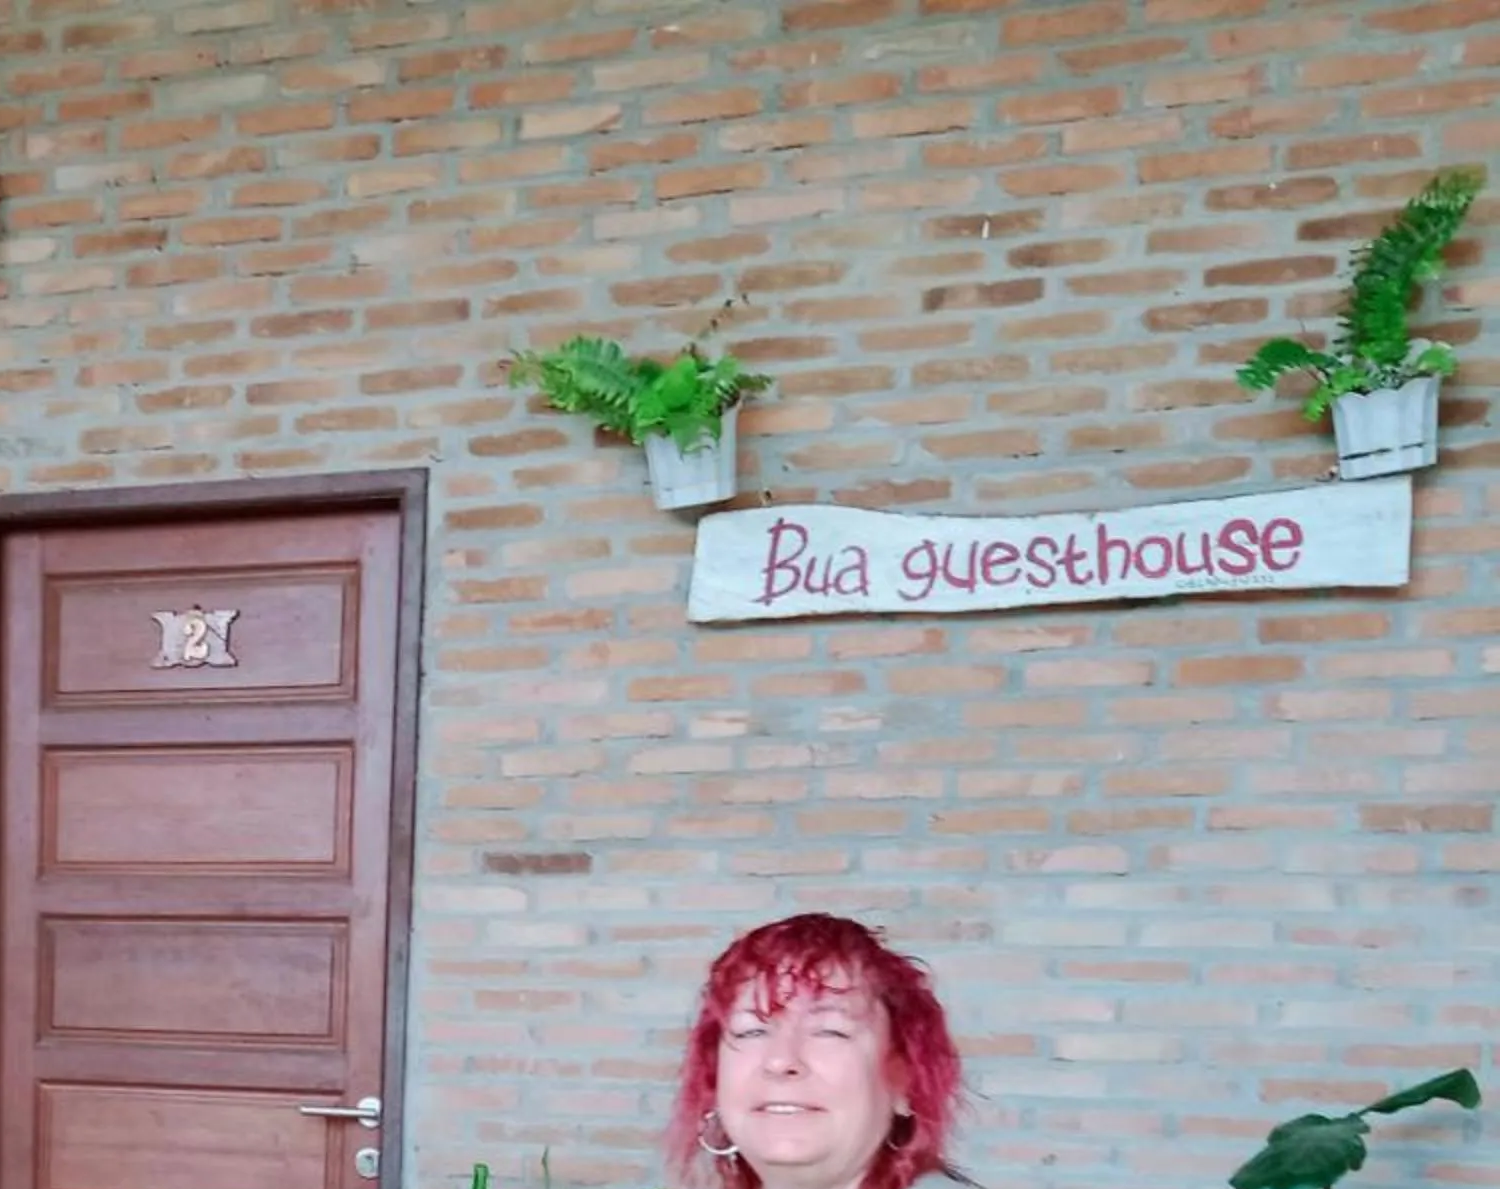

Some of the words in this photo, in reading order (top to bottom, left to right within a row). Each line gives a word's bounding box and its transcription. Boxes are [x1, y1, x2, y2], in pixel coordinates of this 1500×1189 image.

[752, 517, 870, 606] Bua
[898, 518, 1303, 602] guesthouse
[185, 618, 209, 661] 2
